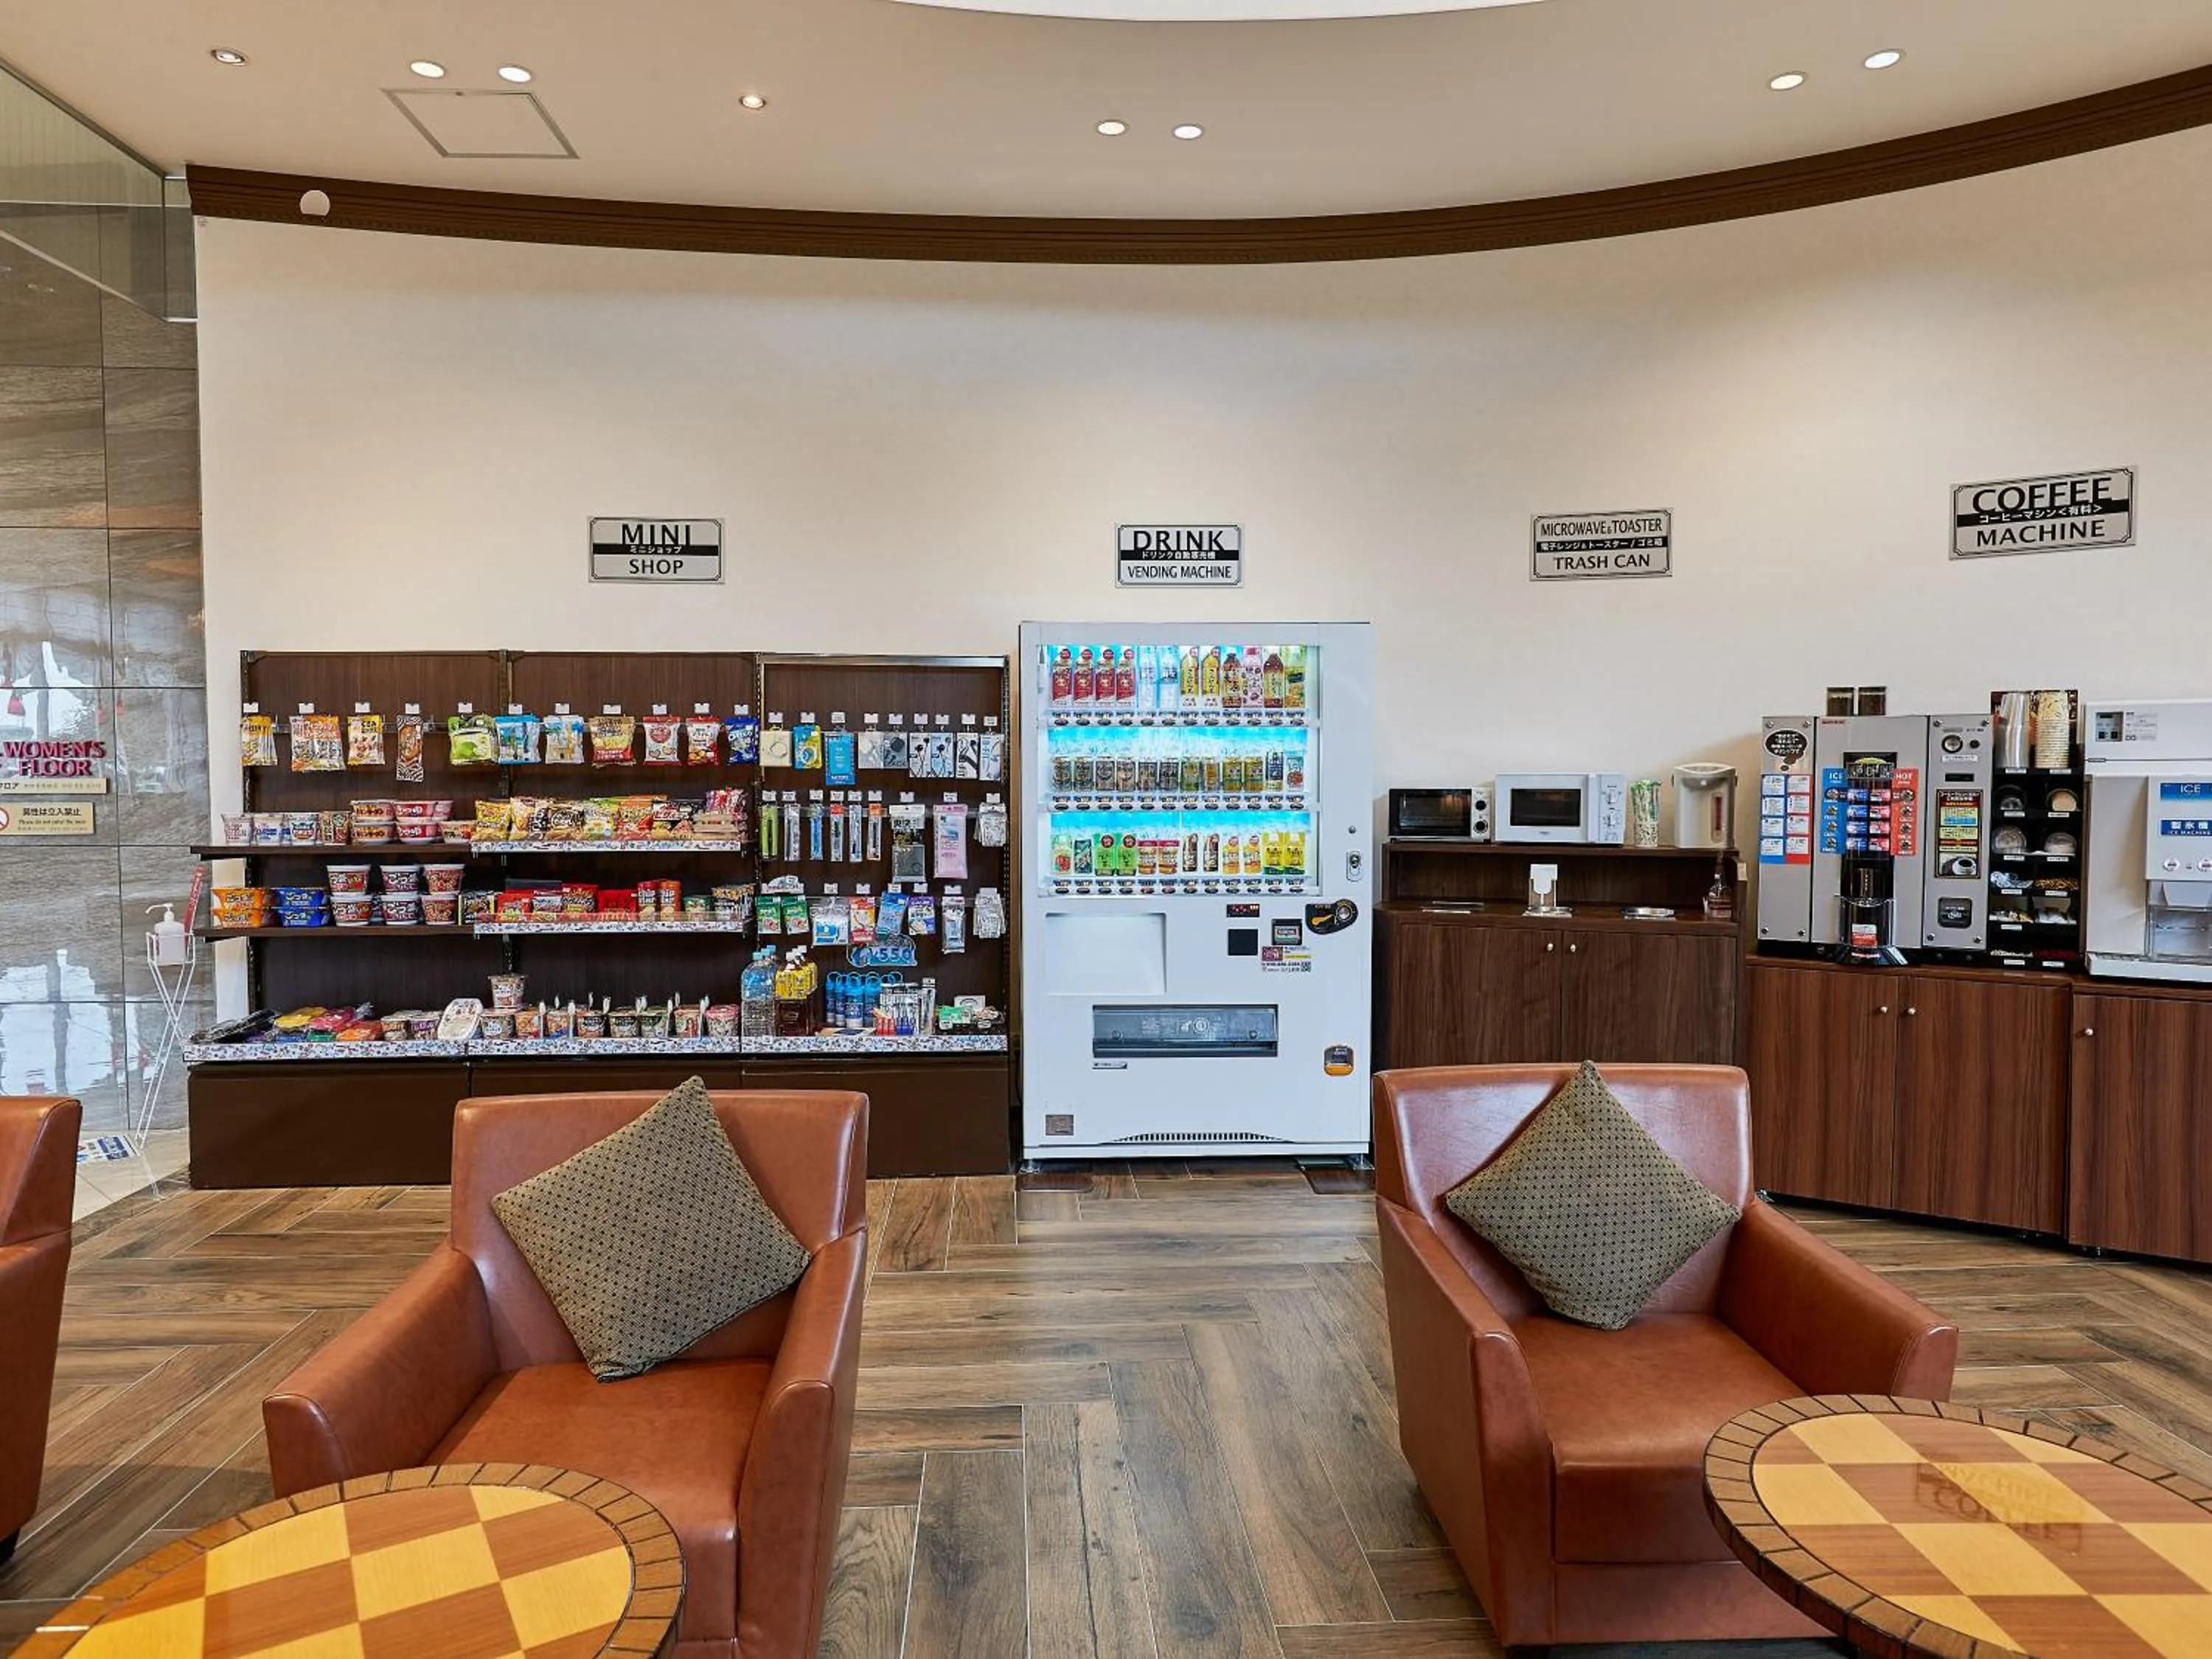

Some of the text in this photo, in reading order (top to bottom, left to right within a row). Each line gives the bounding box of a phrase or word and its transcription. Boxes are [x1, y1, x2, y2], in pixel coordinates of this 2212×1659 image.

[1972, 477, 2112, 514] COFFEE
[622, 524, 691, 546] MINI
[1133, 530, 1225, 552] DRINK
[1977, 520, 2105, 546] MACHINE
[629, 559, 684, 574] SHOP
[1554, 554, 1650, 570] TRASH CAN
[1127, 566, 1232, 578] VENDING MACHINE
[3, 740, 106, 758] WOMEN'S
[19, 759, 93, 776] FLOOR
[2180, 784, 2201, 793] ICE
